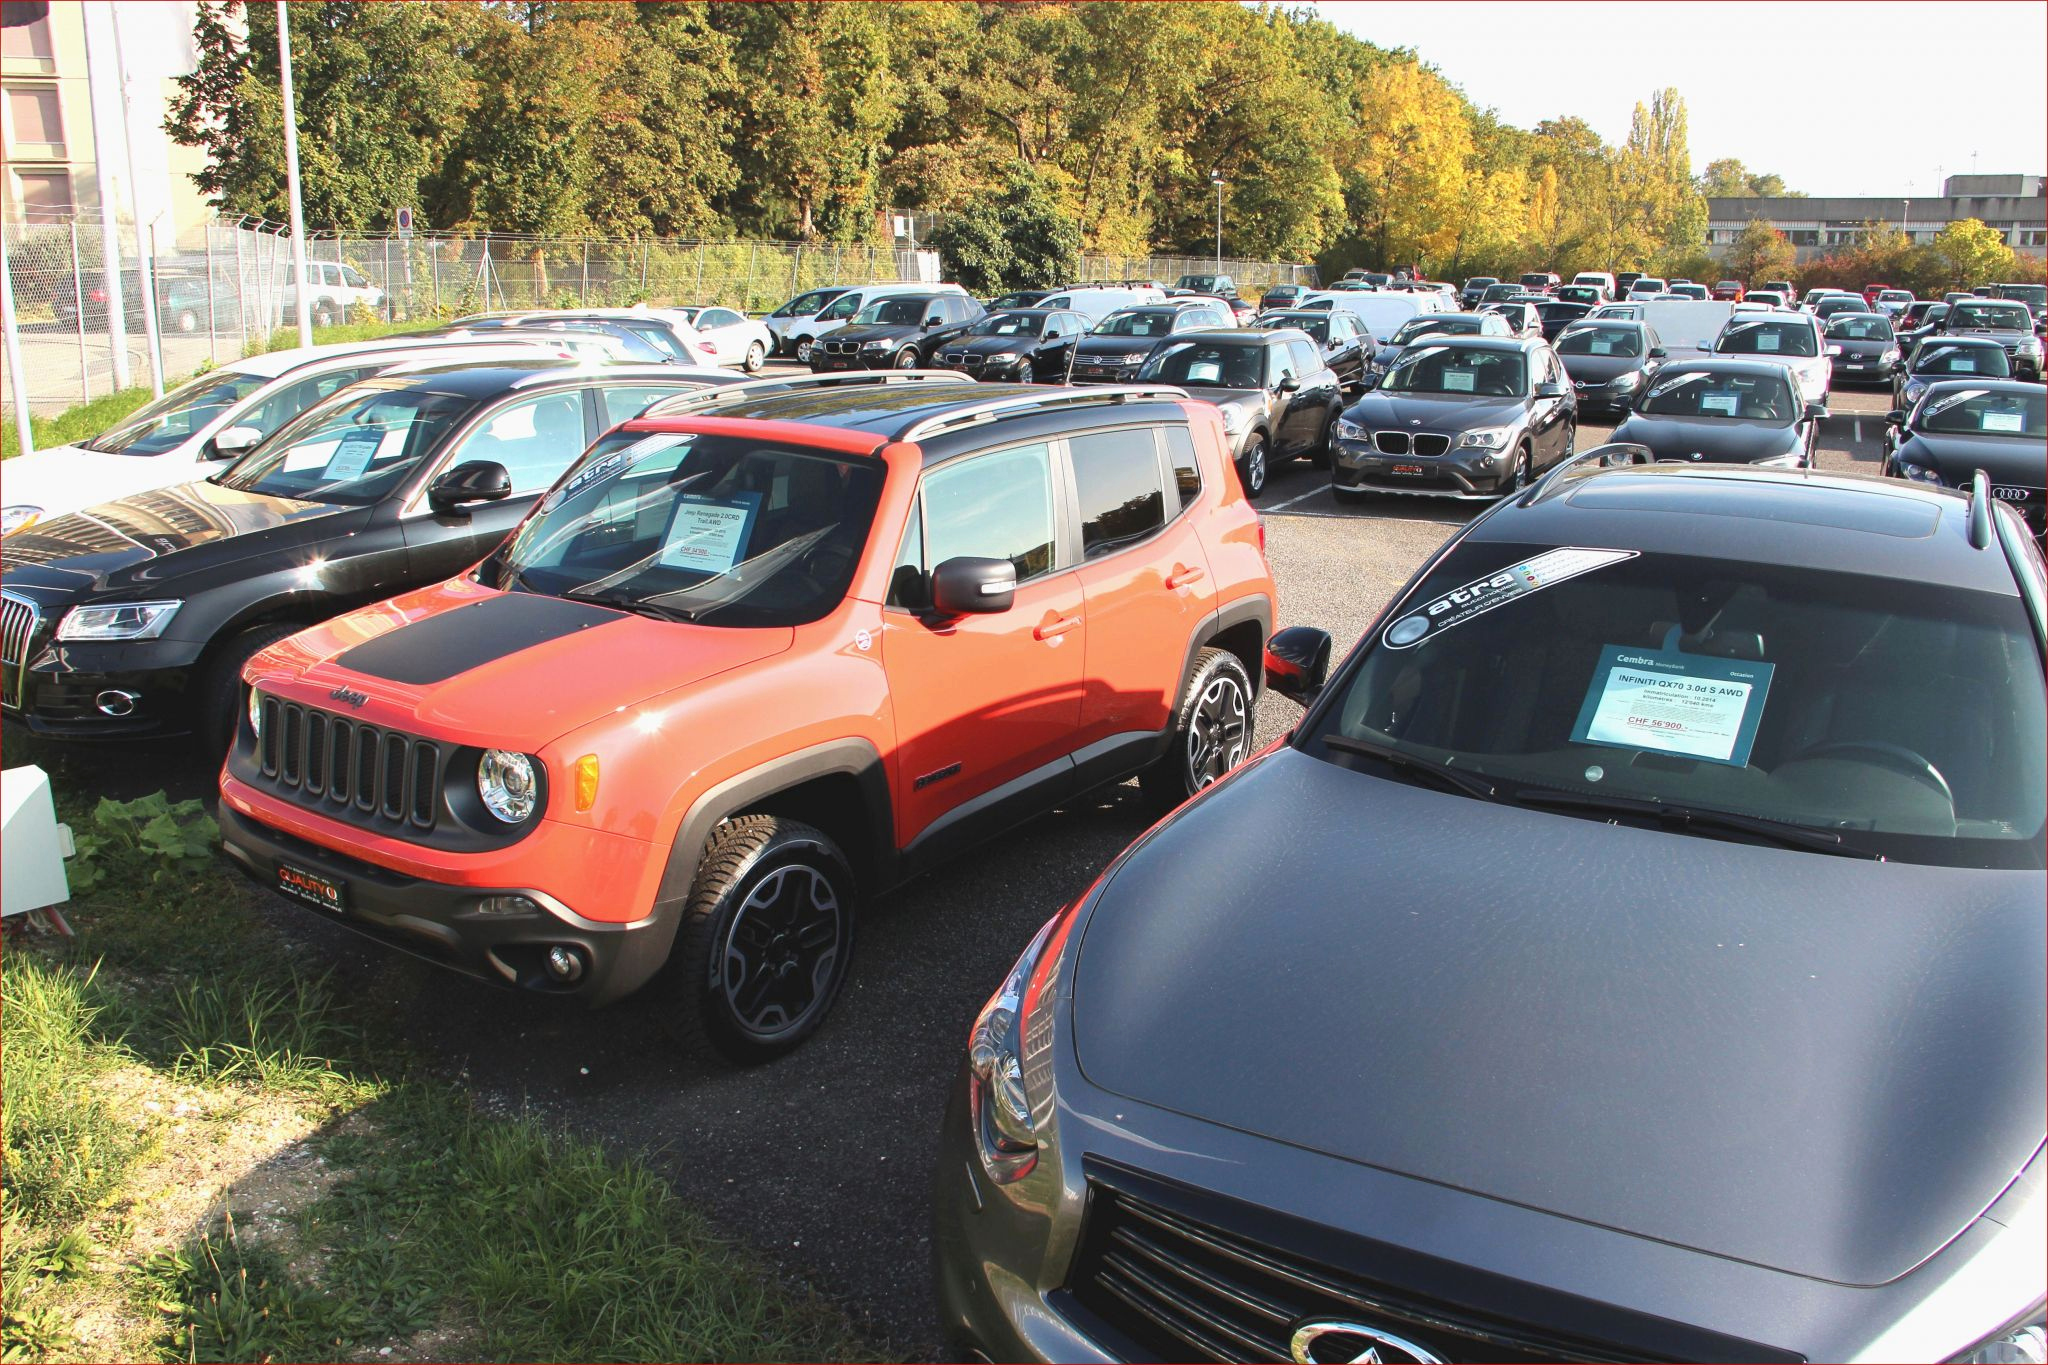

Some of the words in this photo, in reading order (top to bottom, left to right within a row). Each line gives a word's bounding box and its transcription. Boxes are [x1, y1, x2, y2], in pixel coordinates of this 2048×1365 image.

[696, 510, 720, 520] Renegade
[1428, 573, 1514, 615] atra
[1617, 654, 1655, 666] Cembra
[1618, 674, 1656, 686] INFINITI
[1658, 680, 1685, 691] QX70
[1686, 684, 1707, 694] 3.0d
[1718, 688, 1744, 698] AWD
[1628, 716, 1649, 726] CHF
